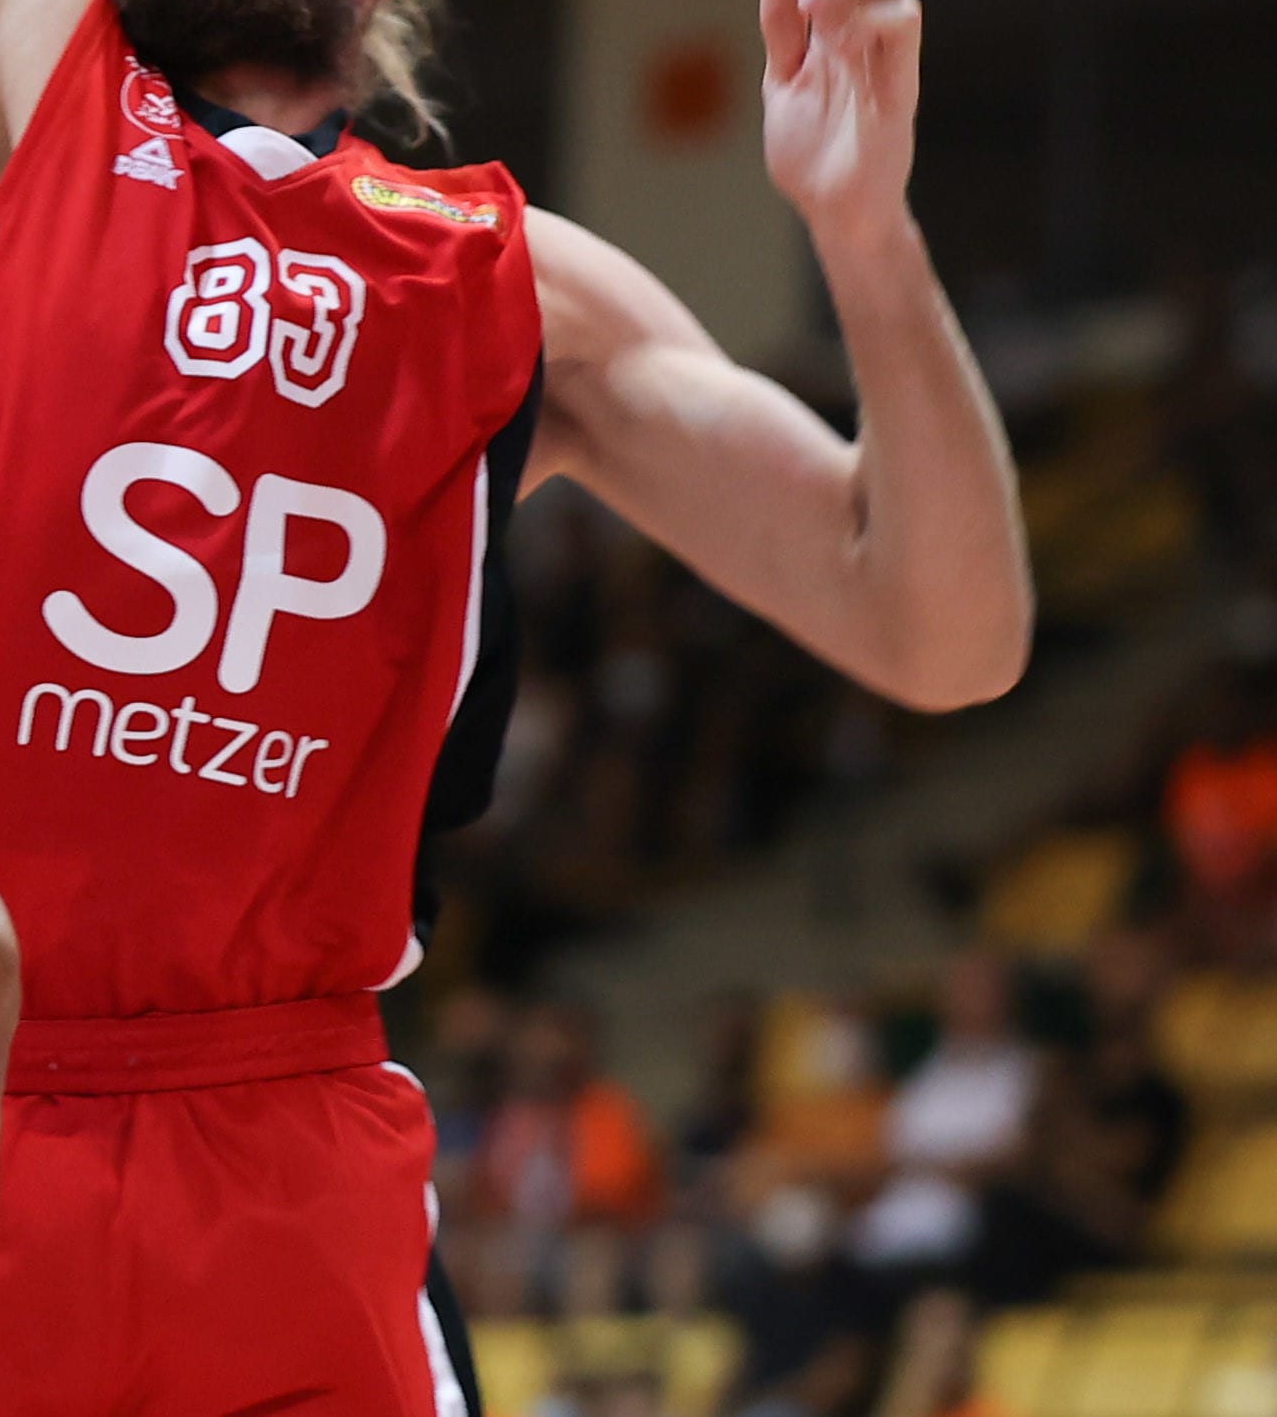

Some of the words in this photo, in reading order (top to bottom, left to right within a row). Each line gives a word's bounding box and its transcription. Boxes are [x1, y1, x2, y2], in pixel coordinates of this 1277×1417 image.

[163, 237, 367, 408] 83
[41, 441, 388, 694] SP
[17, 682, 330, 798] metzer
